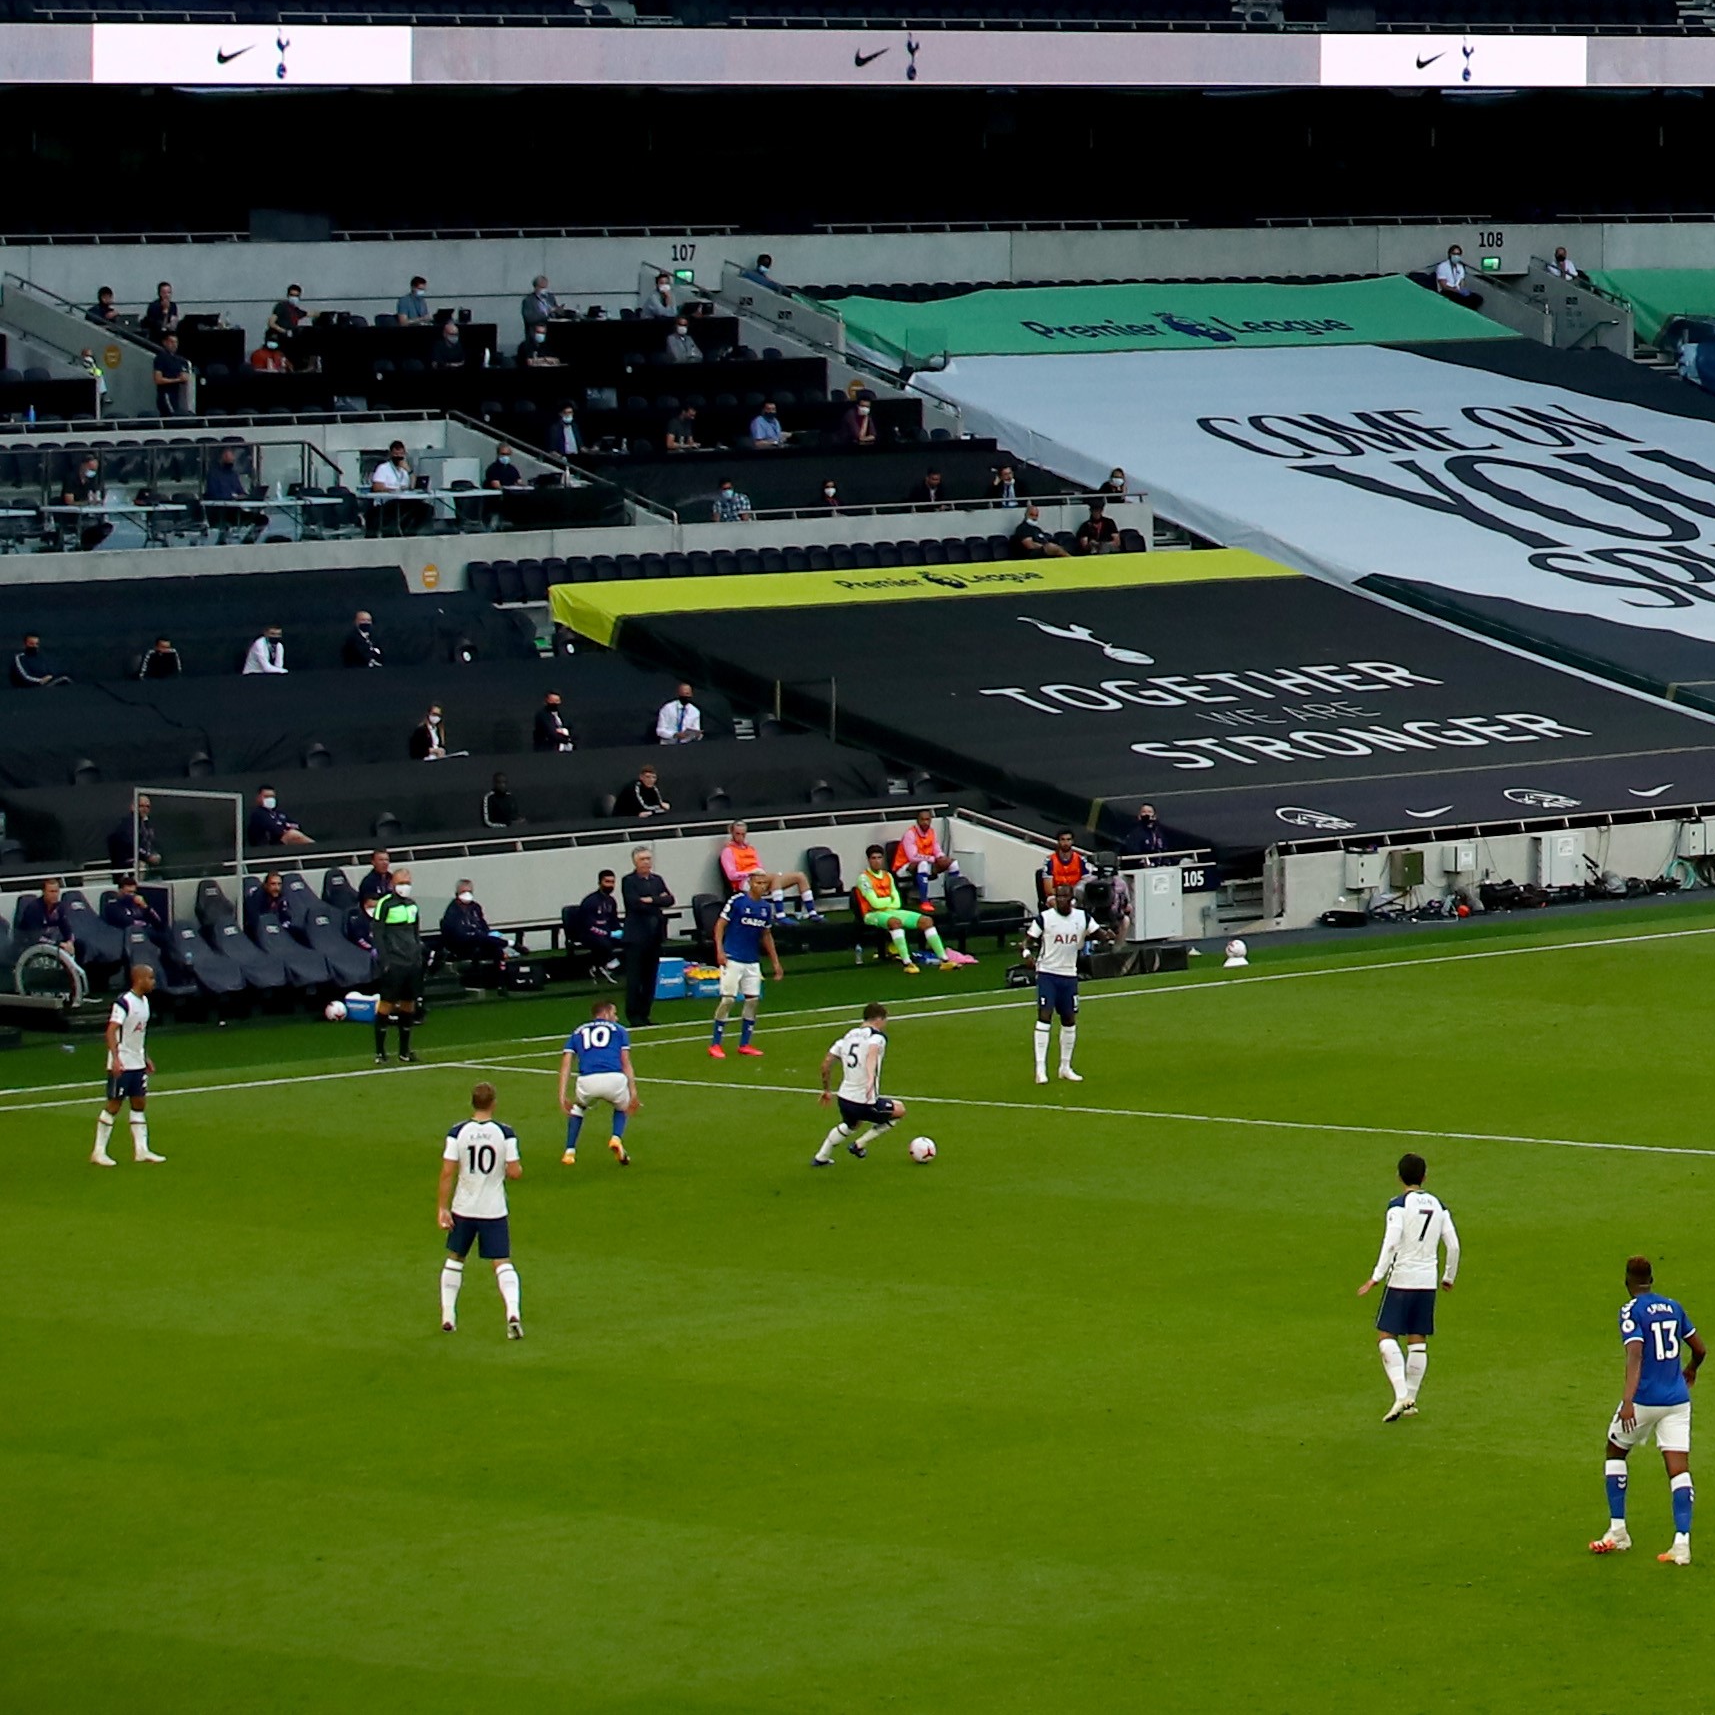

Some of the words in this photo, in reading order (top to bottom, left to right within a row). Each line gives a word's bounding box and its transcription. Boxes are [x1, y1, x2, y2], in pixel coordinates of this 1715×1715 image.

[671, 243, 697, 261] 107
[1479, 232, 1504, 248] 108
[1020, 319, 1166, 340] Premier
[1209, 315, 1355, 336] League
[1196, 409, 1478, 459] COME
[1461, 403, 1646, 449] ON
[833, 578, 924, 590] Premier
[953, 571, 1044, 583] League
[980, 659, 1443, 715] TOGETHER
[1195, 709, 1287, 728] WE
[1283, 700, 1381, 723] ARE
[1130, 712, 1592, 769] STRONGER
[1183, 870, 1205, 887] 105
[1053, 934, 1080, 945] AIA
[581, 1025, 610, 1049] 10
[846, 1043, 860, 1068] 5
[467, 1145, 496, 1174] 10
[1418, 1209, 1434, 1242] 7
[1651, 1320, 1678, 1361] 13
